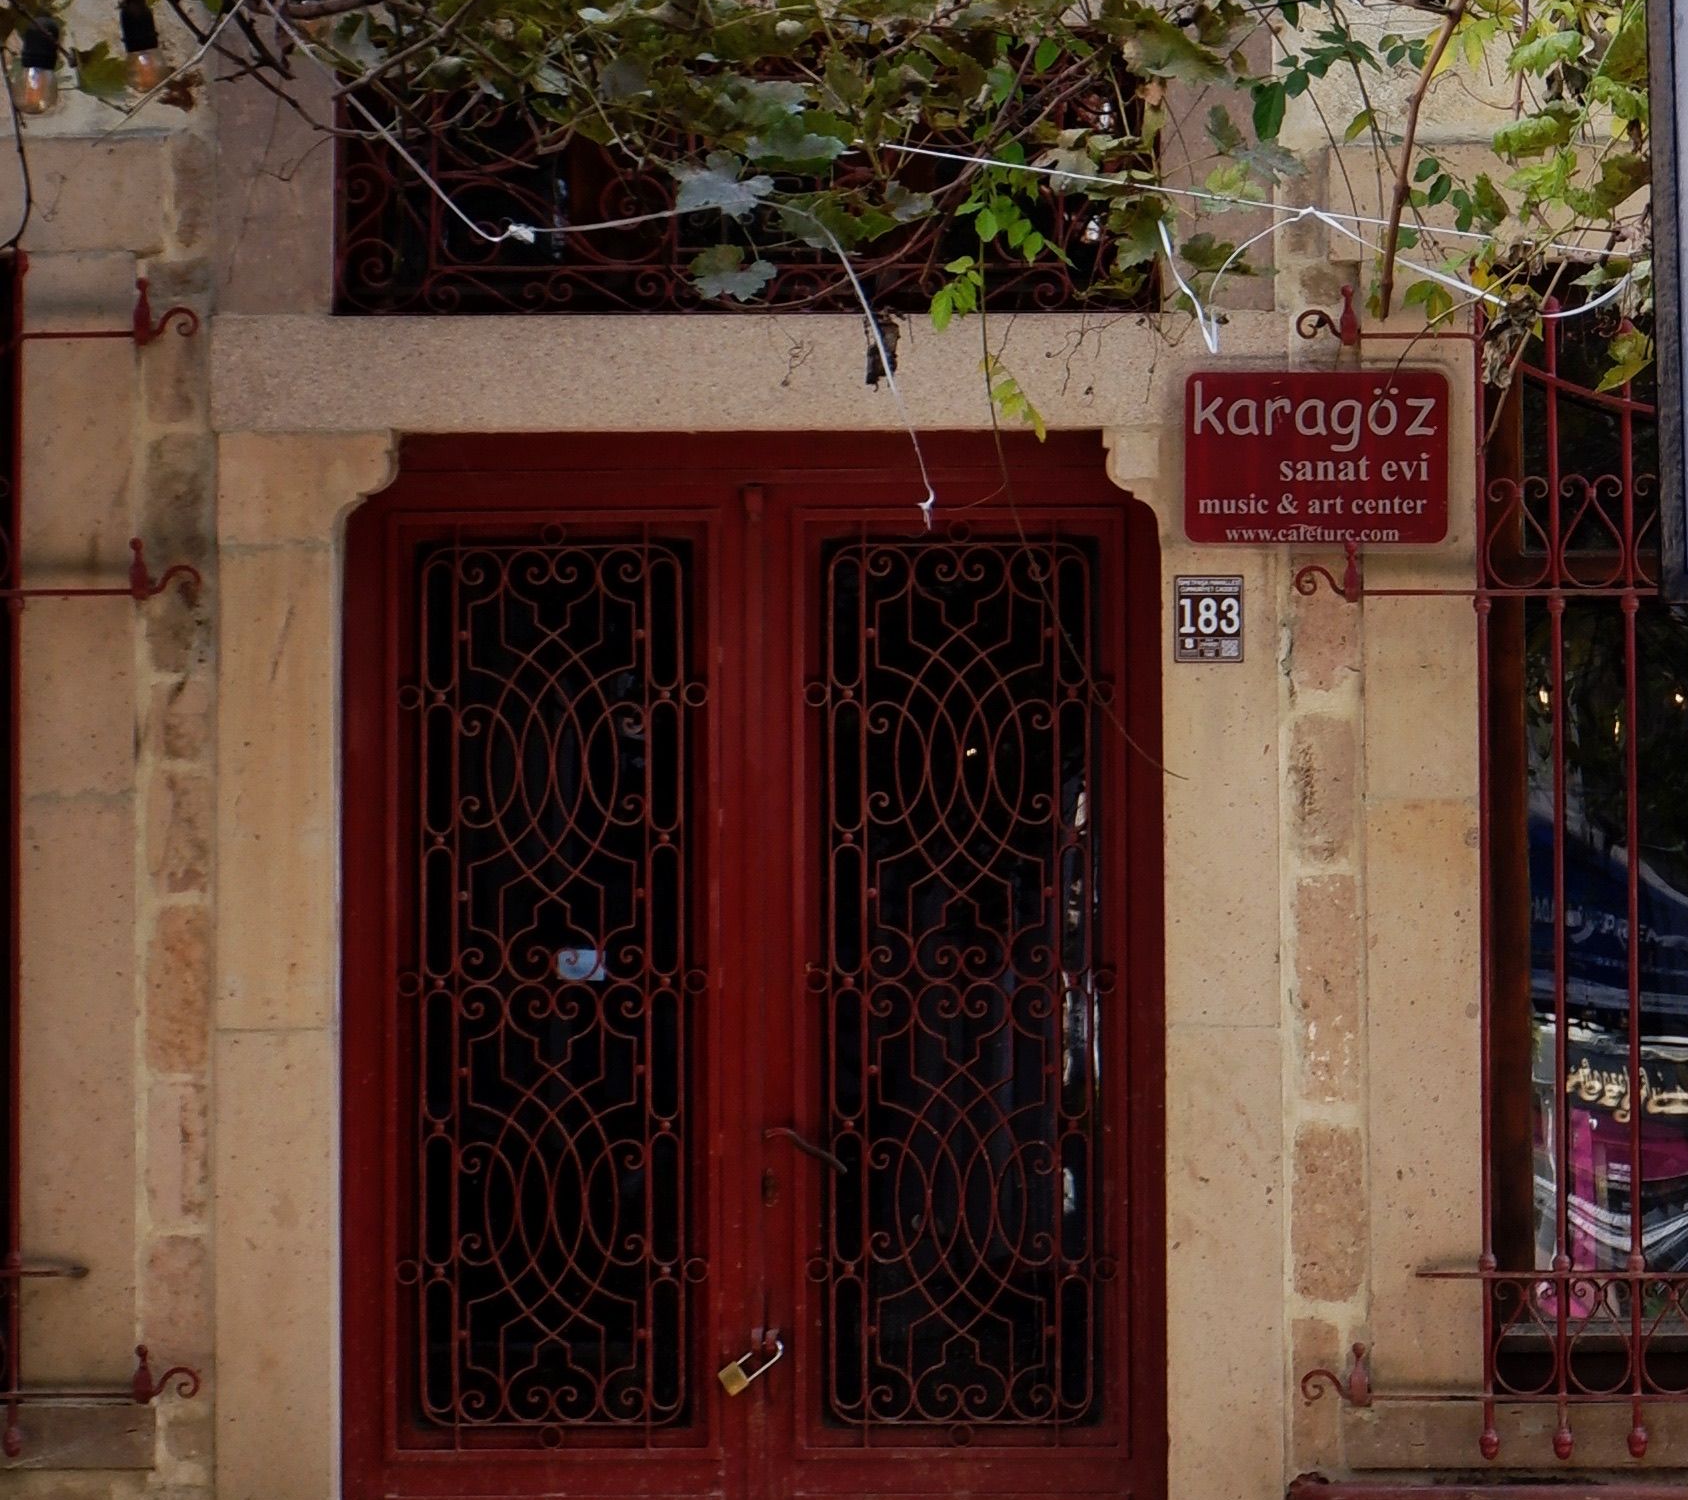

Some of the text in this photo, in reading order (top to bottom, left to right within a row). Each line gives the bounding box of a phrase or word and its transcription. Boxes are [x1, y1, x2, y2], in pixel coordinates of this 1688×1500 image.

[1192, 380, 1437, 453] karagöz
[1279, 452, 1430, 482] sanat evi
[1198, 492, 1428, 515] music & art center
[1179, 597, 1240, 635] 183
